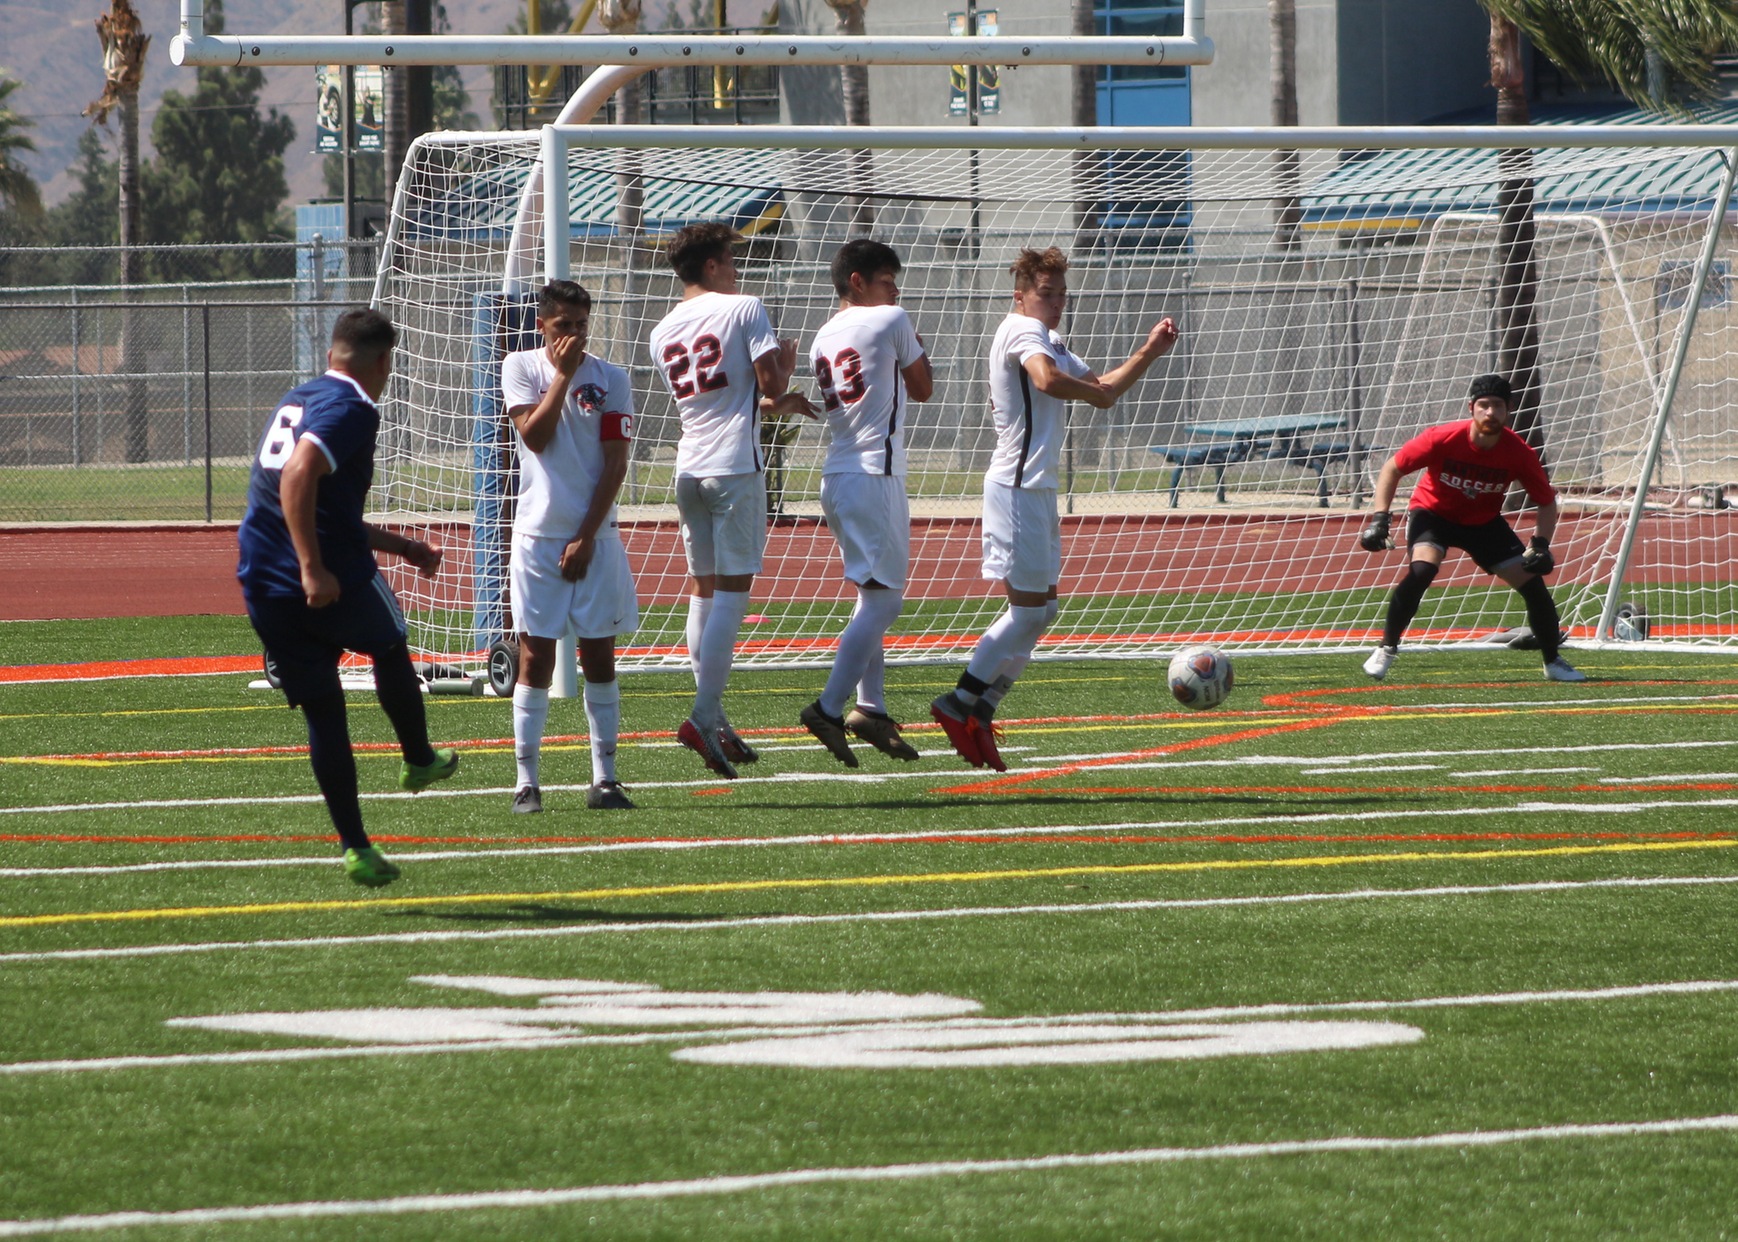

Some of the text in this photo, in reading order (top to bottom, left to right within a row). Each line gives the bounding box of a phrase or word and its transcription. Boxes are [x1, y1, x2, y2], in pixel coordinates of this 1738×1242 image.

[663, 333, 729, 400] 22
[815, 347, 866, 412] 23
[259, 405, 303, 470] 6
[621, 416, 632, 438] C
[1439, 472, 1504, 492] SOCCER
